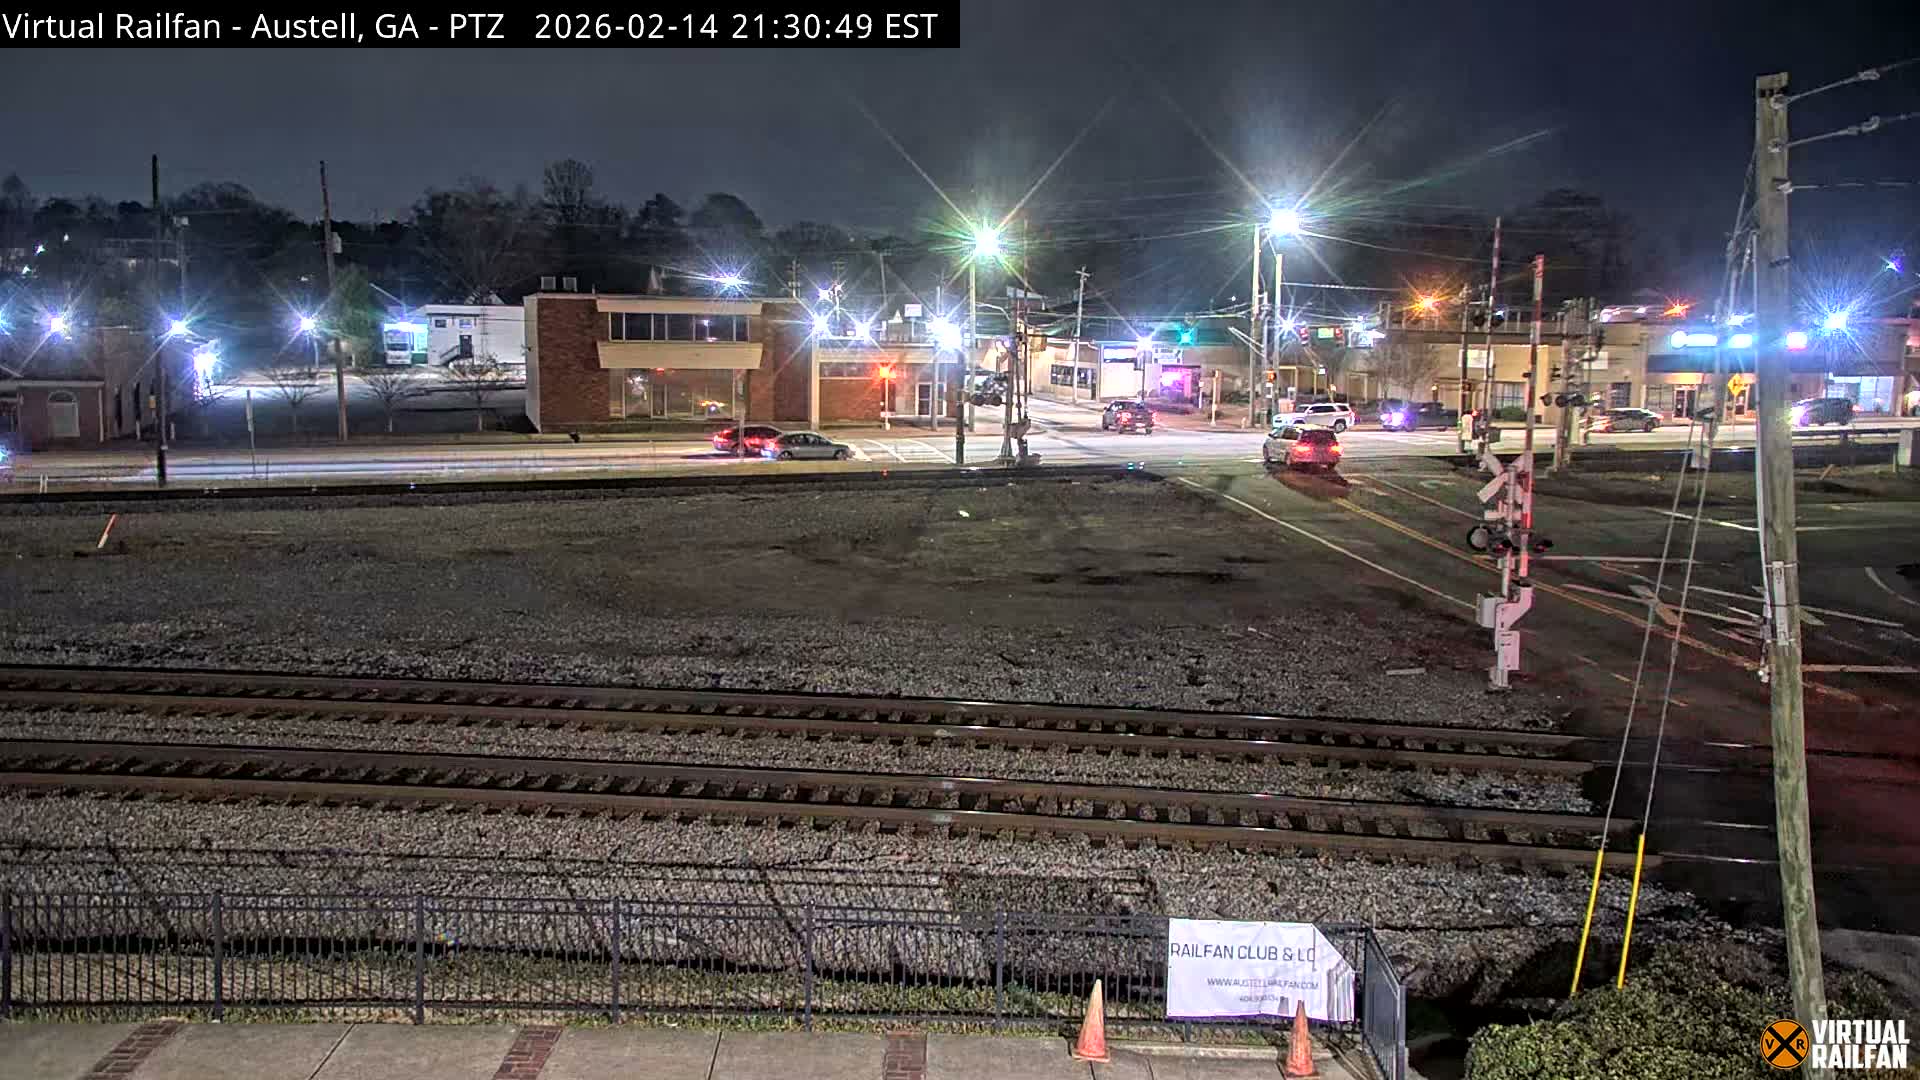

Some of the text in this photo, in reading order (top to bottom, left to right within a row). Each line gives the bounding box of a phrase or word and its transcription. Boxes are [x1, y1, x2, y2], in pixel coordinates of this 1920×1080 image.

[1170, 943, 1234, 960] RAILFAN
[1237, 945, 1278, 961] CLUB
[1282, 947, 1293, 962] &
